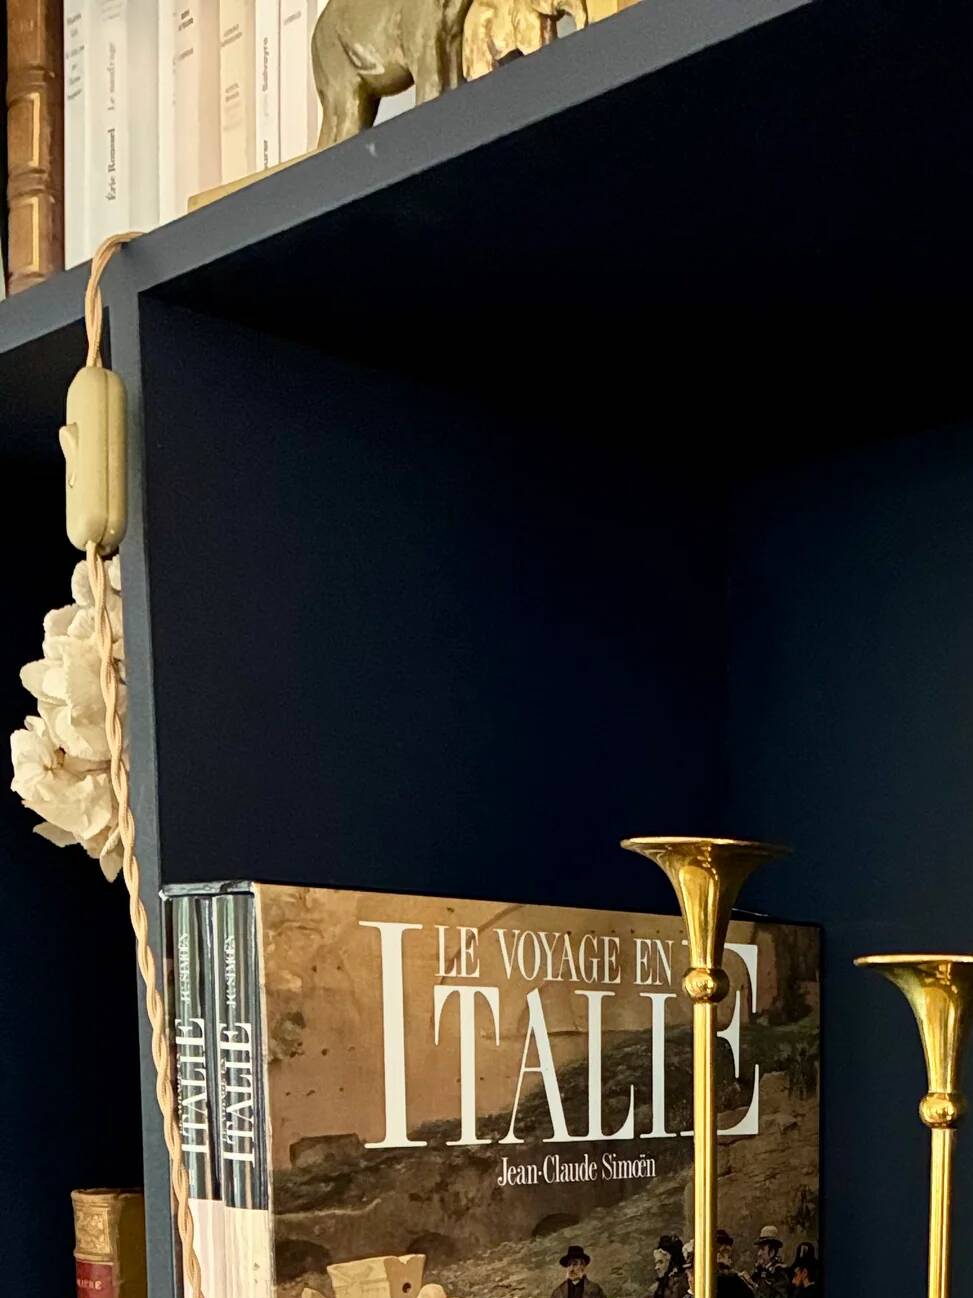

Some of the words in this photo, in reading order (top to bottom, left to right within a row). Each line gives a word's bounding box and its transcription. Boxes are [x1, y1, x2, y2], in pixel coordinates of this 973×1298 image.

[433, 924, 480, 978] LE
[493, 927, 623, 985] VOYAGE
[633, 937, 676, 986] EN
[174, 1017, 209, 1156] ITALIE
[219, 1021, 256, 1169] ITALIE
